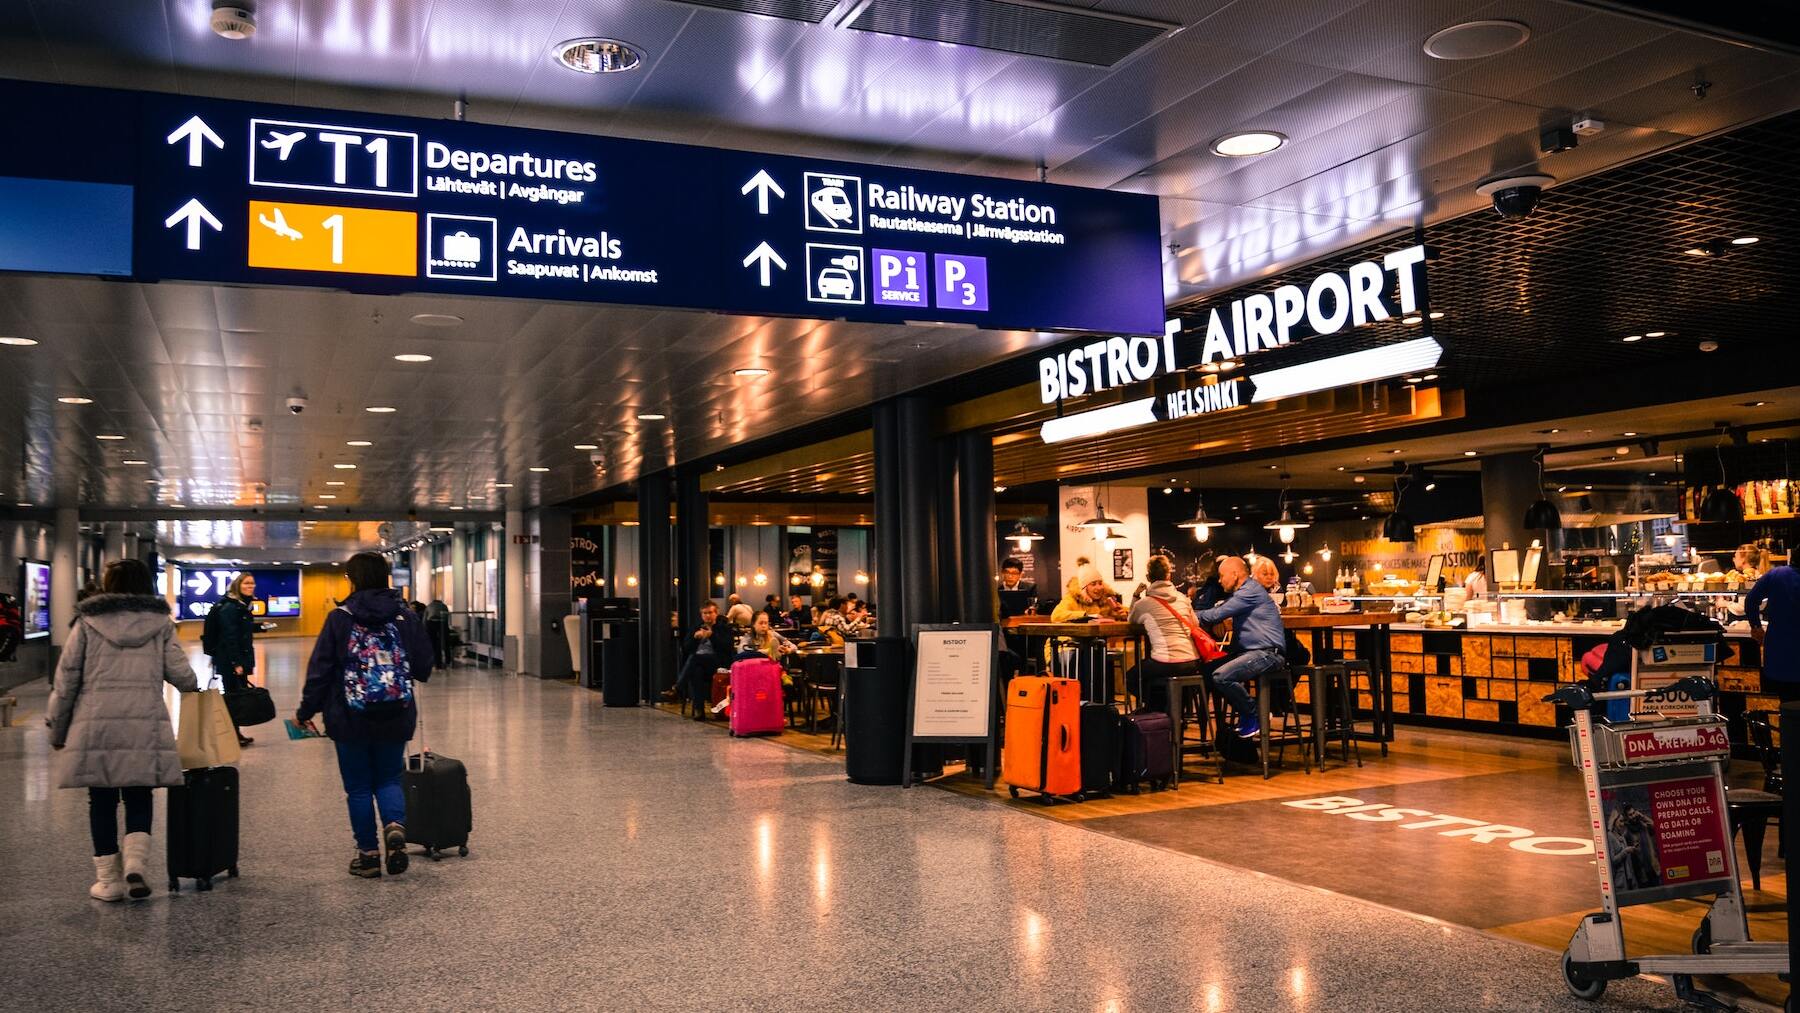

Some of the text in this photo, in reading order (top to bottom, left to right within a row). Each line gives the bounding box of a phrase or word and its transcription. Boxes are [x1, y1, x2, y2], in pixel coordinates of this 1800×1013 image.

[319, 133, 388, 187] T1
[426, 142, 597, 182] Departures
[427, 176, 584, 204] Lähtevät Avgångar
[868, 183, 1056, 225] Railway Station
[321, 214, 344, 265] 1
[507, 226, 622, 259] Arrivals
[869, 213, 1065, 245] Rautatieasema Järnvägsstation
[507, 260, 658, 283] Saapuvat Ankomst
[881, 289, 920, 303] SERVICE
[1039, 244, 1426, 405] BISTROT AIRPORT
[1166, 379, 1239, 420] HELSINKI
[1628, 733, 1725, 752] DNA PREPAID 4G
[1654, 786, 1705, 799] CHOOSE YOUR
[1656, 796, 1707, 809] OWN DNA FOR
[1657, 806, 1714, 819] PREPAID CALLS,
[1659, 817, 1702, 829] 4G DATA OR
[1281, 796, 1597, 861] BISTRO
[1661, 829, 1696, 840] ROAMING
